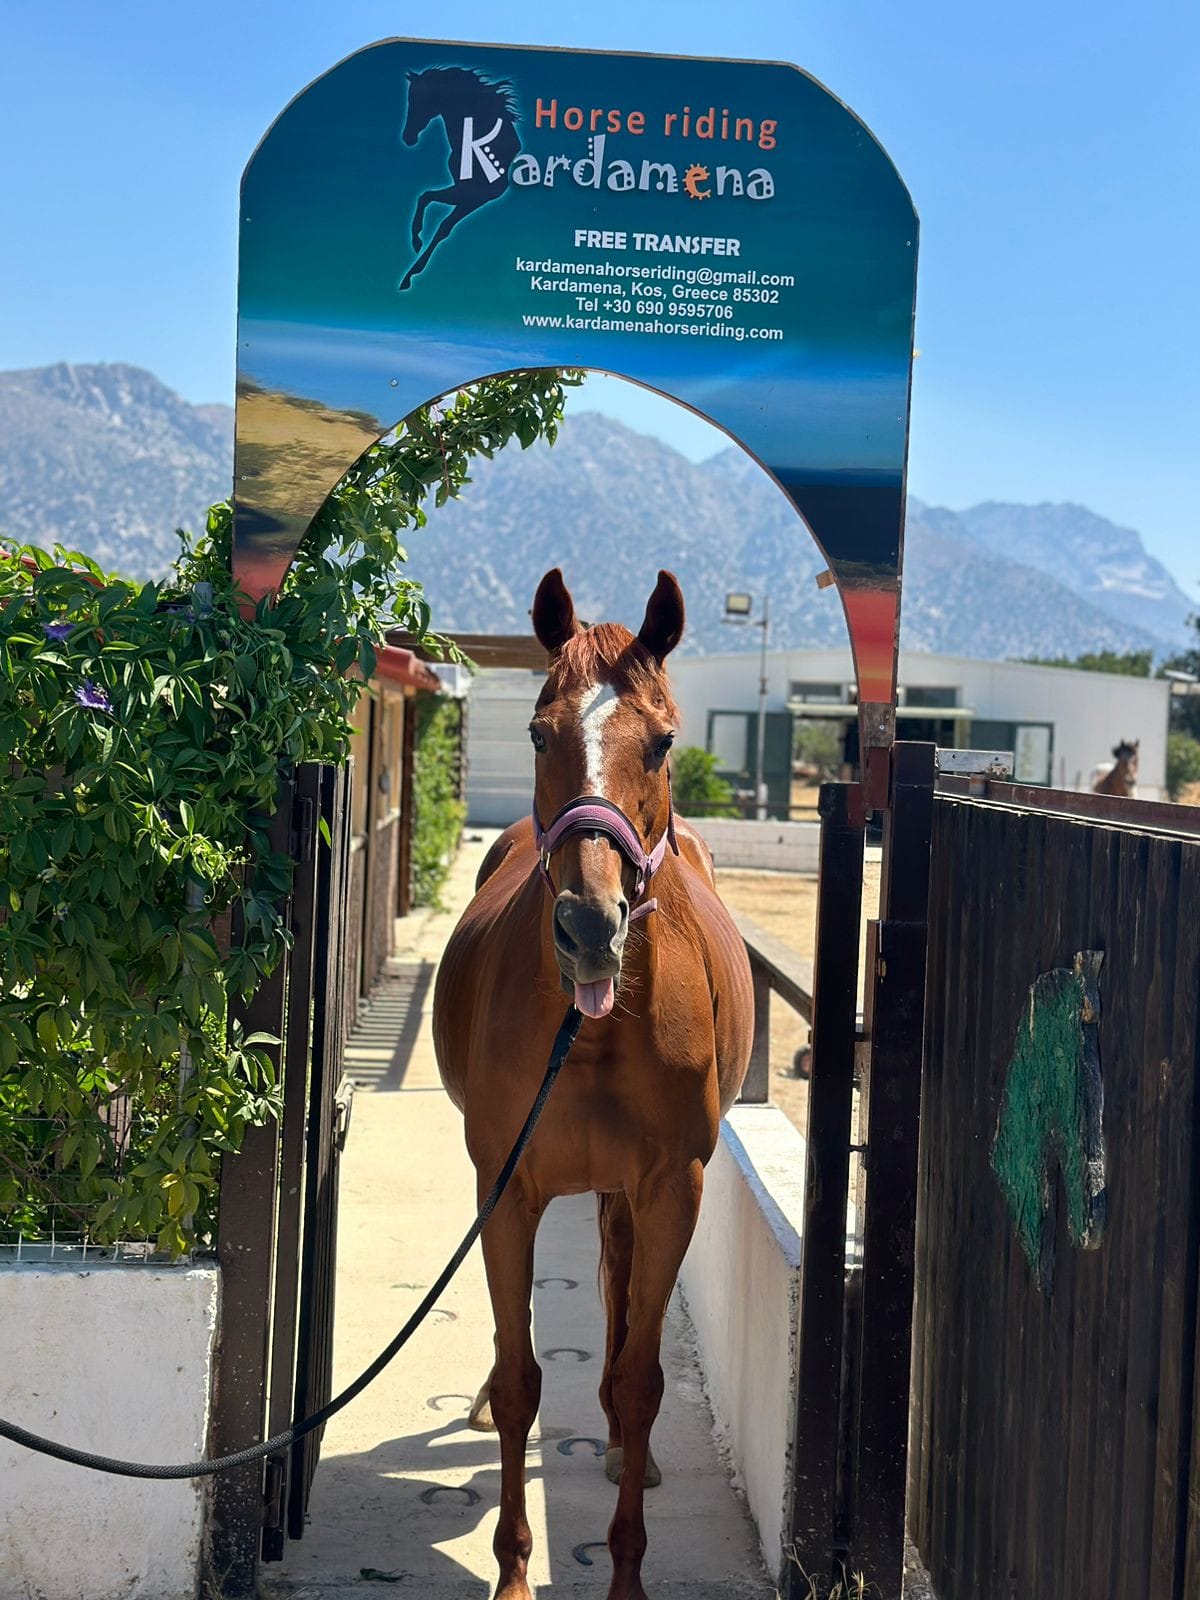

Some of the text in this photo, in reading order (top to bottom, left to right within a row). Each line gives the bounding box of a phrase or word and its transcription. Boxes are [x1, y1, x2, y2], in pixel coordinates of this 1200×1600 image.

[535, 98, 778, 150] Horse riding
[459, 117, 775, 200] Kardamena
[574, 229, 741, 257] FREE TRANSFER
[516, 257, 795, 286] kardamenahorseriding@gmail.com
[531, 276, 779, 304] Kardamena, Kos, Greece 85302
[575, 297, 734, 320] Tel +30 690 9595706
[522, 314, 783, 341] www.kardamenahorseriding.com
